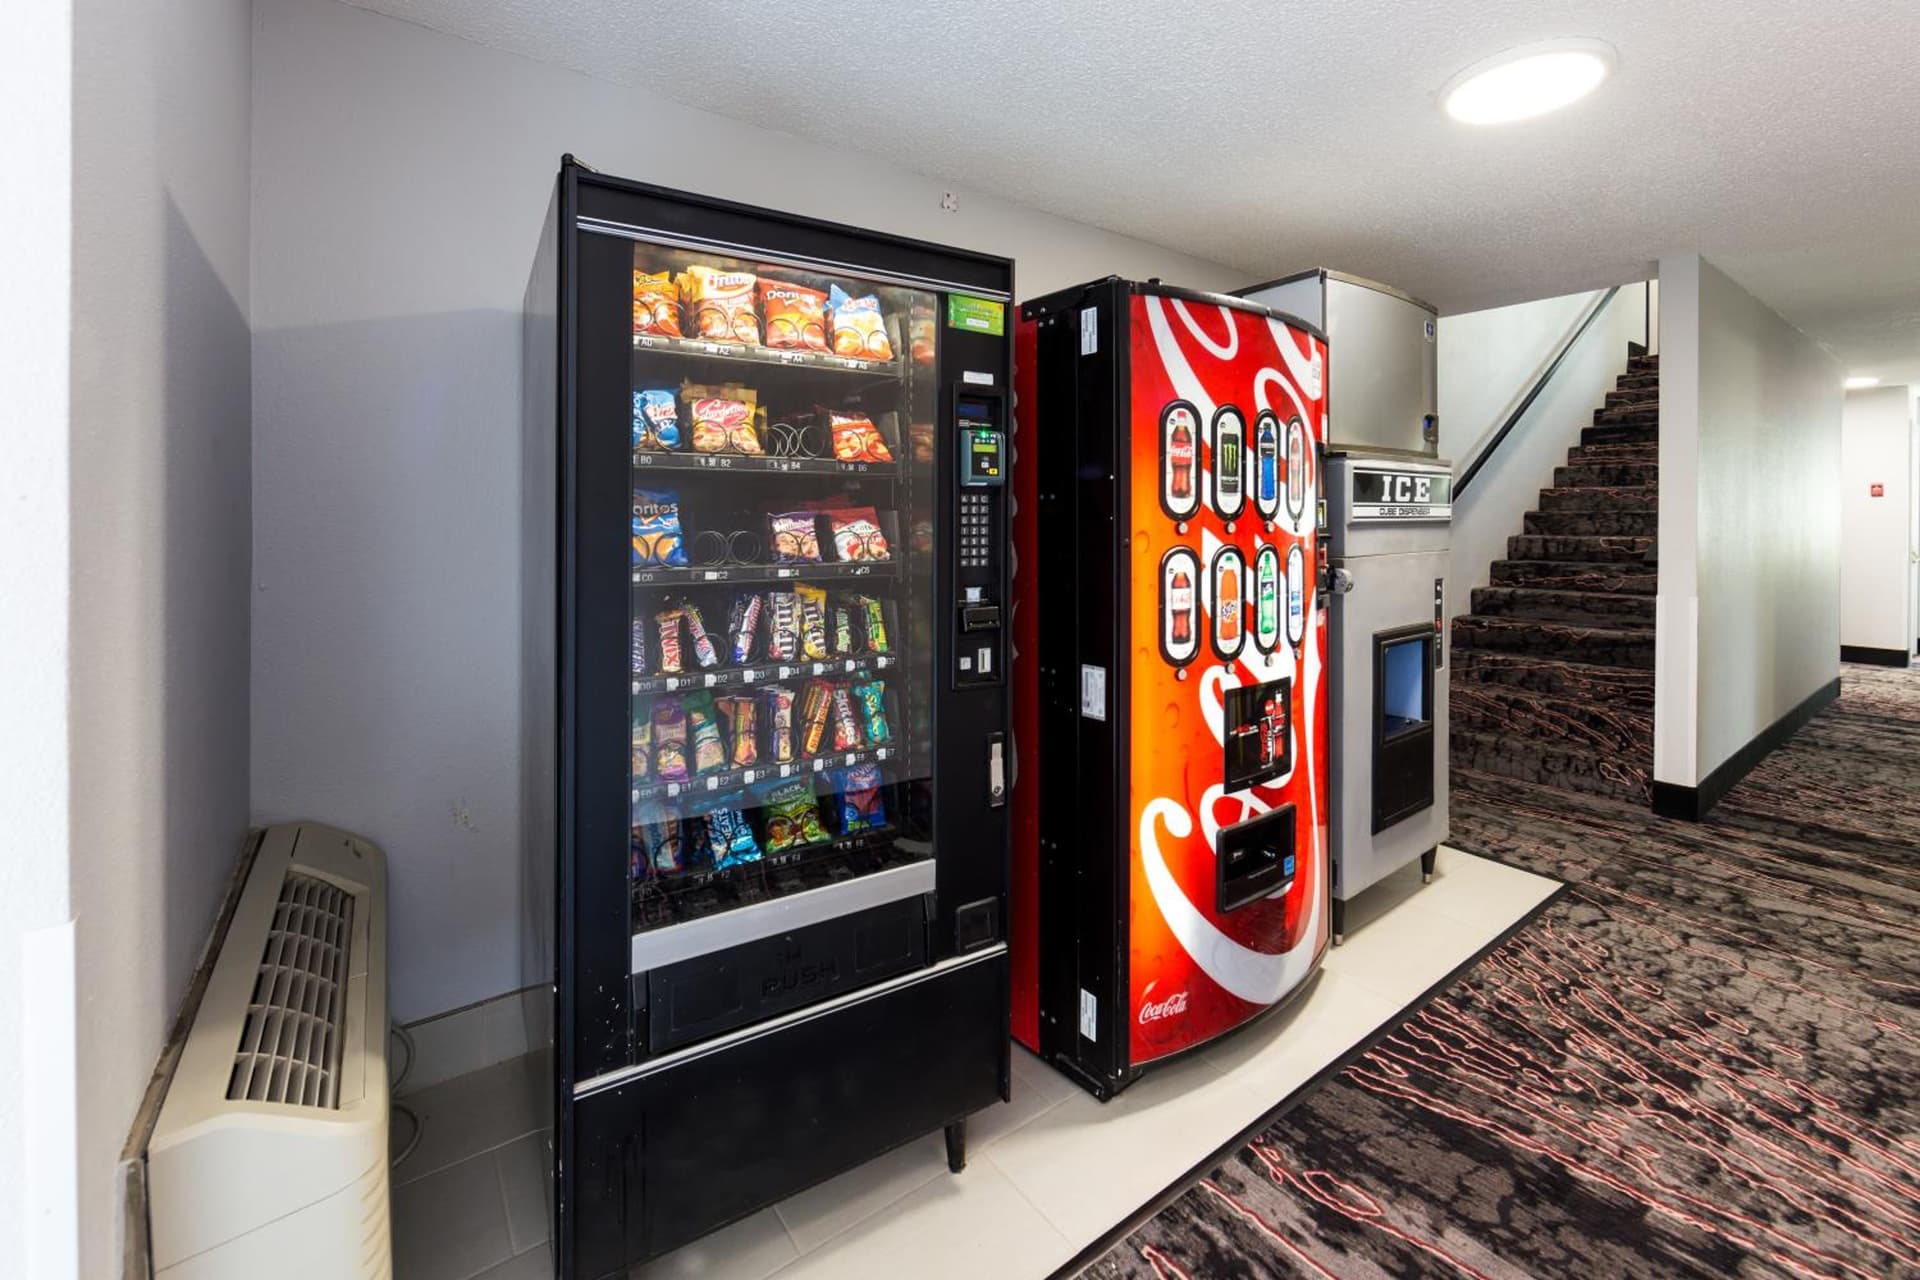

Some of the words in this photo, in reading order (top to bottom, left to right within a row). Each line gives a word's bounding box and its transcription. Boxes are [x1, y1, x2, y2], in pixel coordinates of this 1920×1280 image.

[1381, 475, 1431, 502] ICE
[633, 502, 679, 516] oritos
[680, 678, 690, 688] D1
[1139, 991, 1190, 1025] Coca-Cola
